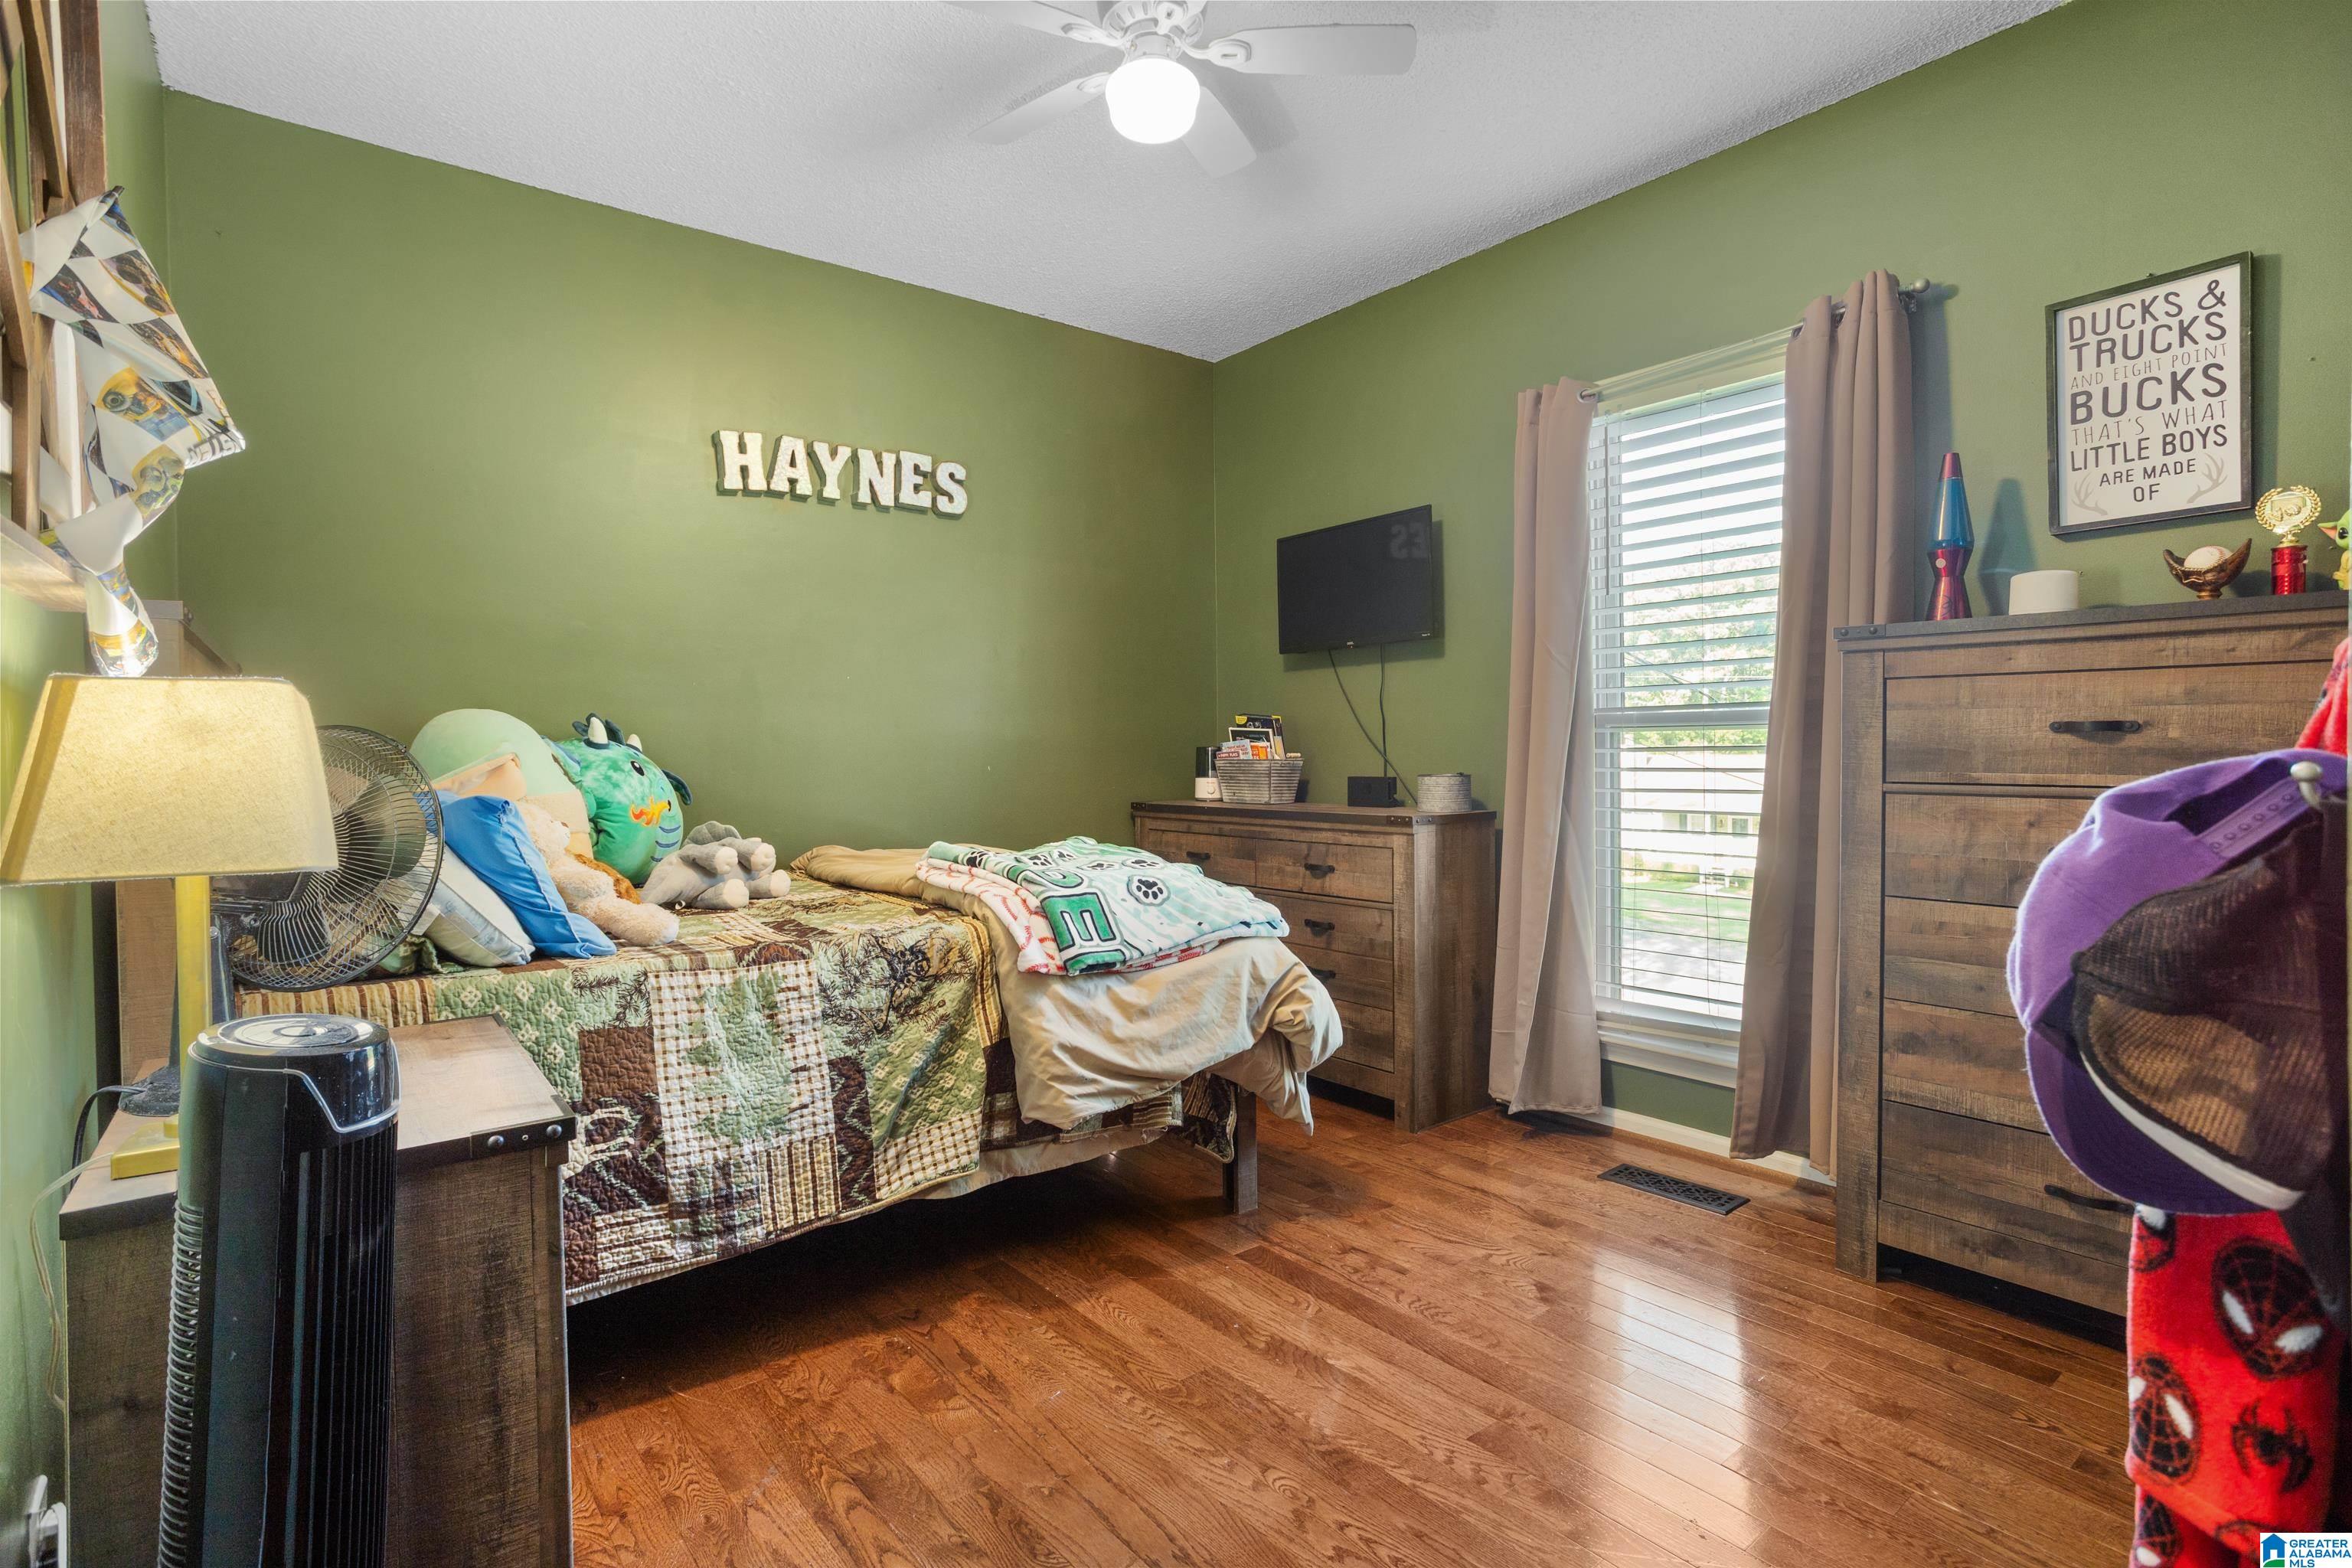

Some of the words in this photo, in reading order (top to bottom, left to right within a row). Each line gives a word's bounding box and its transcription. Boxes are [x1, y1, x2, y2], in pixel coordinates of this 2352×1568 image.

[2069, 291, 2183, 343] DUCKS
[2197, 279, 2226, 311] &
[2069, 312, 2227, 372] TRUCKS
[2070, 371, 2104, 390] AND
[2113, 358, 2162, 381] EIGHT
[2171, 342, 2227, 369] POINT
[2070, 363, 2227, 426] BUCKS
[2071, 416, 2145, 446] THAT'S
[2161, 400, 2227, 430] WHAT
[2071, 437, 2150, 472] LITTLE
[2161, 424, 2227, 457] BOYS
[712, 429, 969, 519] HAYNES
[2099, 469, 2135, 487] ARE
[2143, 458, 2197, 480] MADE
[2133, 483, 2161, 503] OF
